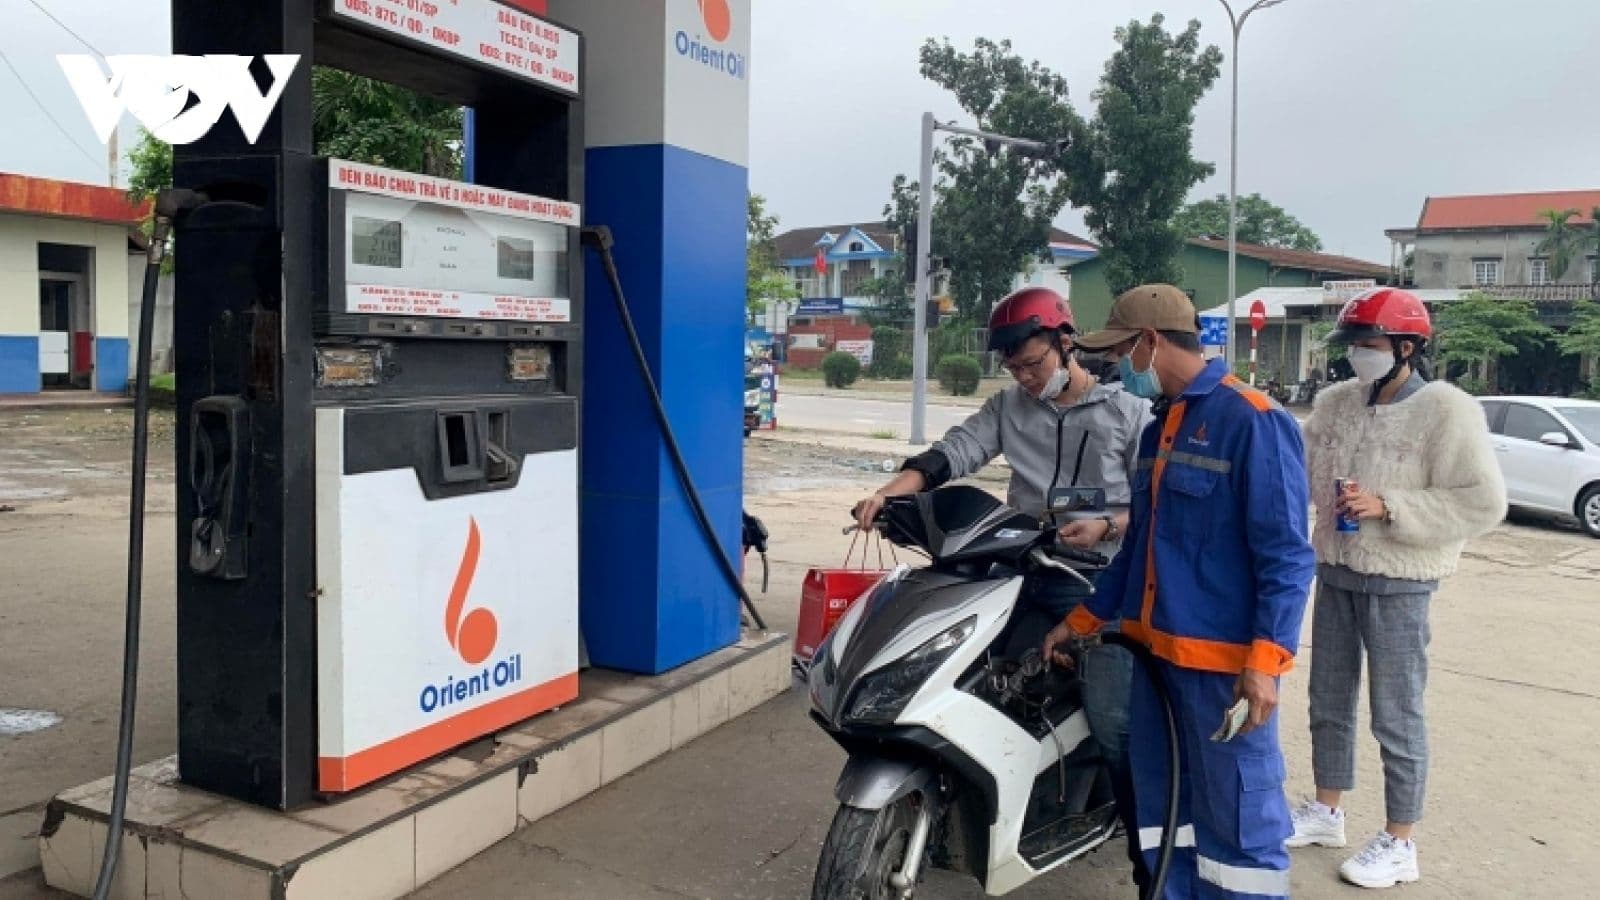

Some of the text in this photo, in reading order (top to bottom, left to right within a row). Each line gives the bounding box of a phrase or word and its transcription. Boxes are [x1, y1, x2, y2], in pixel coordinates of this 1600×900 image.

[675, 30, 745, 80] Orient Oil
[420, 654, 521, 713] Orient Oil
